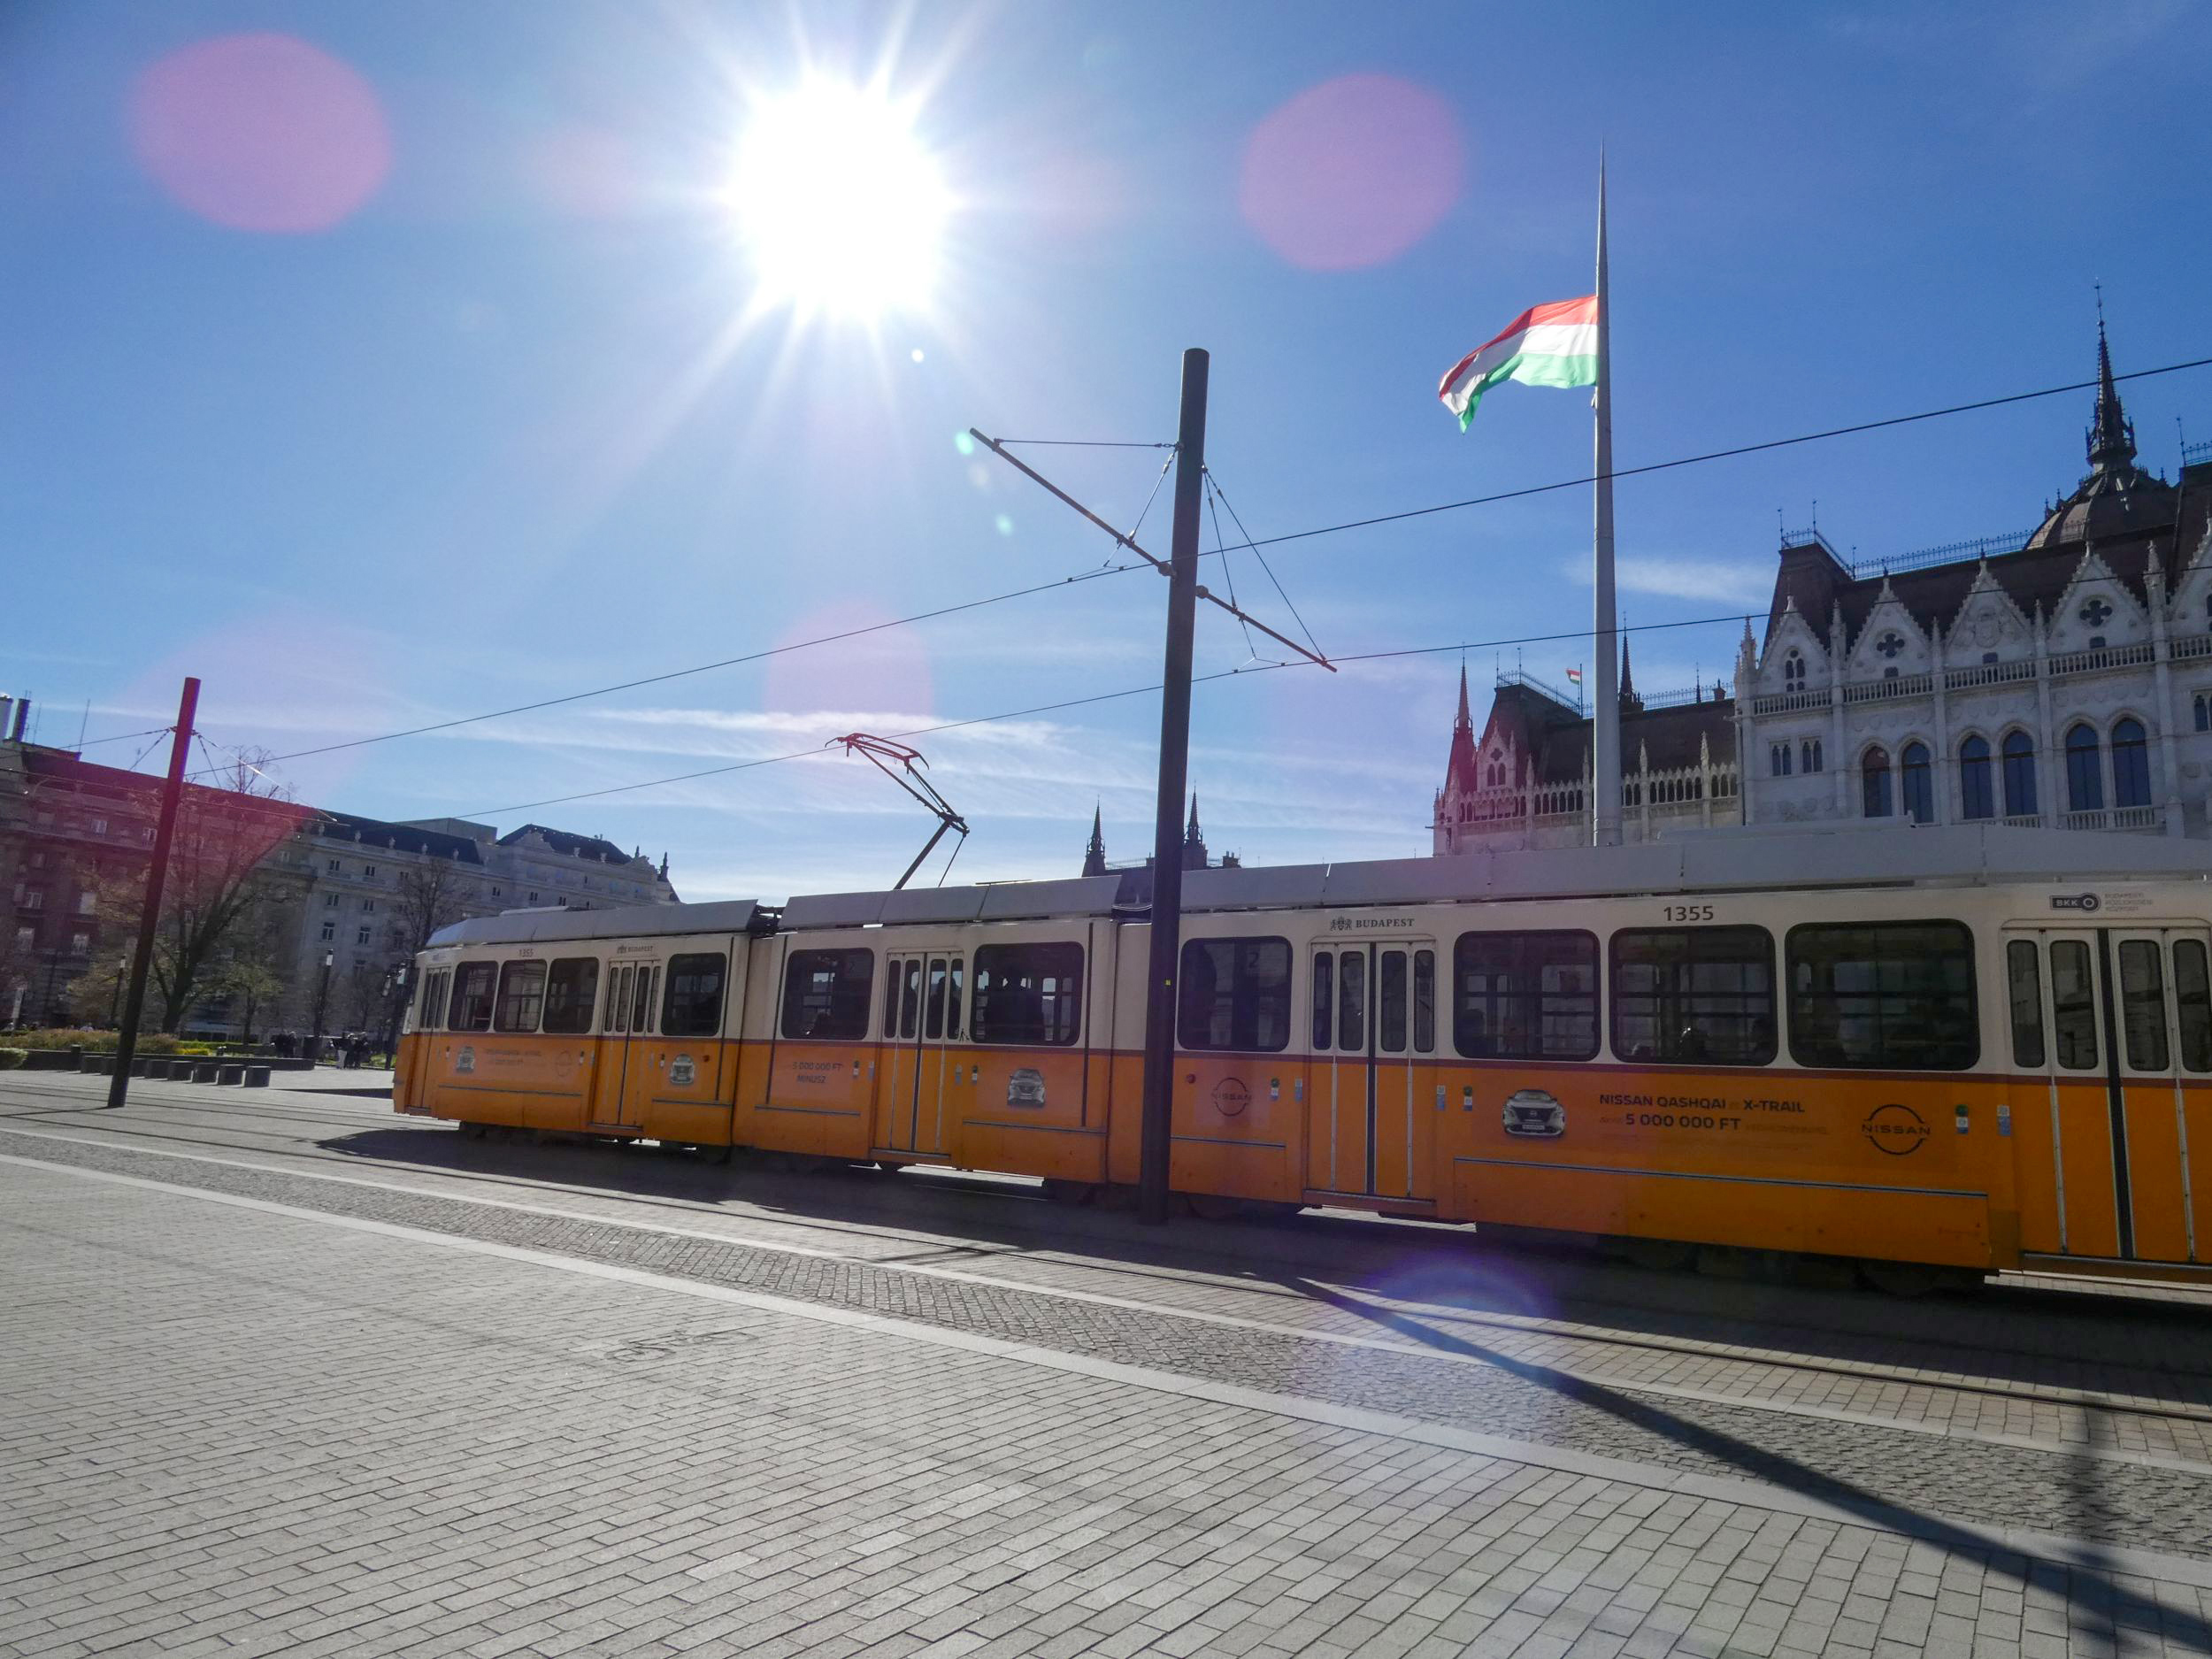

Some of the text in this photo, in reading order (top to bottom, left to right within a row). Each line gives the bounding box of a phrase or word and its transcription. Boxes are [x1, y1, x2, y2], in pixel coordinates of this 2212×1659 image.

[1663, 905, 1714, 921] 1355
[1356, 918, 1416, 928] BUDAPEST
[1600, 1094, 1653, 1106] NISSAN
[1656, 1096, 1727, 1110] QASHQAI
[1743, 1099, 1806, 1113] X-TRAIL
[1625, 1113, 1636, 1125] 5
[1640, 1114, 1675, 1128] 000
[1679, 1116, 1716, 1130] 000
[1719, 1118, 1742, 1131] FT
[1862, 1124, 1931, 1135] NISSAN
